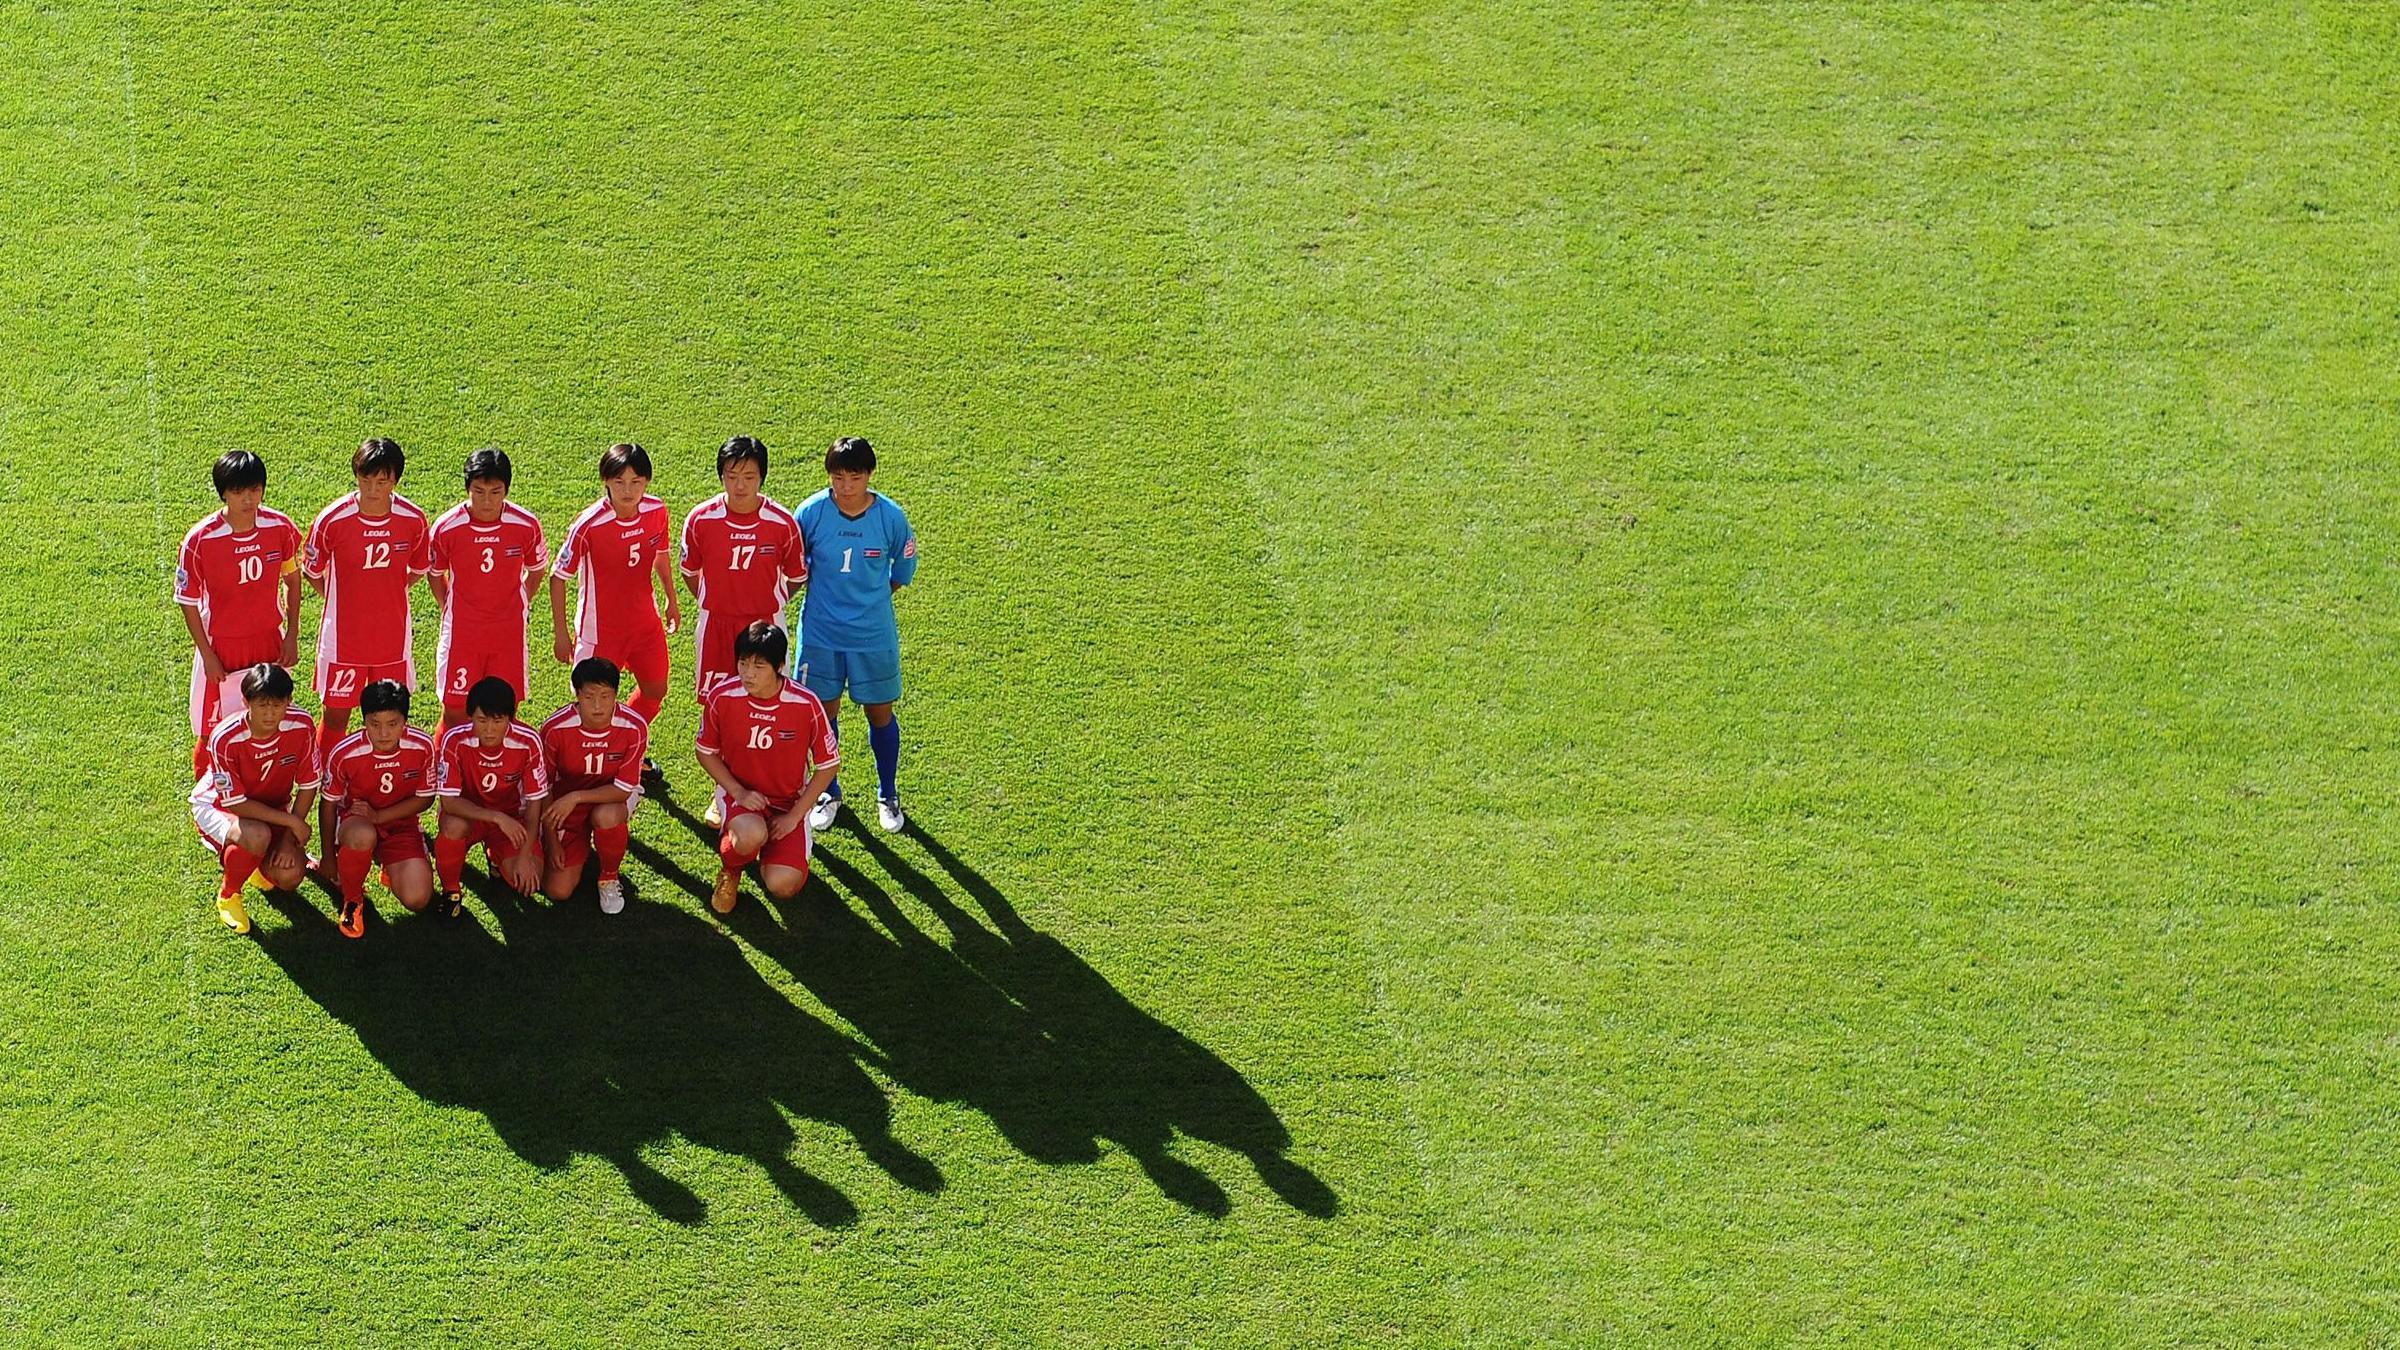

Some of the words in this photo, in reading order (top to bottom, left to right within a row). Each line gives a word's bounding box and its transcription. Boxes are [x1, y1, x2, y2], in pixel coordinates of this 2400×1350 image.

[362, 542, 391, 570] 12
[480, 548, 494, 573] 3
[628, 542, 640, 567] 5
[728, 545, 756, 570] 17
[840, 547, 852, 573] 1
[238, 555, 263, 584] 10
[329, 668, 356, 692] 12
[453, 667, 467, 690] 3
[702, 671, 728, 691] 17
[800, 663, 808, 685] 1
[746, 725, 773, 750] 16
[261, 760, 273, 781] 7
[584, 752, 604, 775] 11
[380, 773, 393, 793] 8
[481, 772, 497, 793] 9
